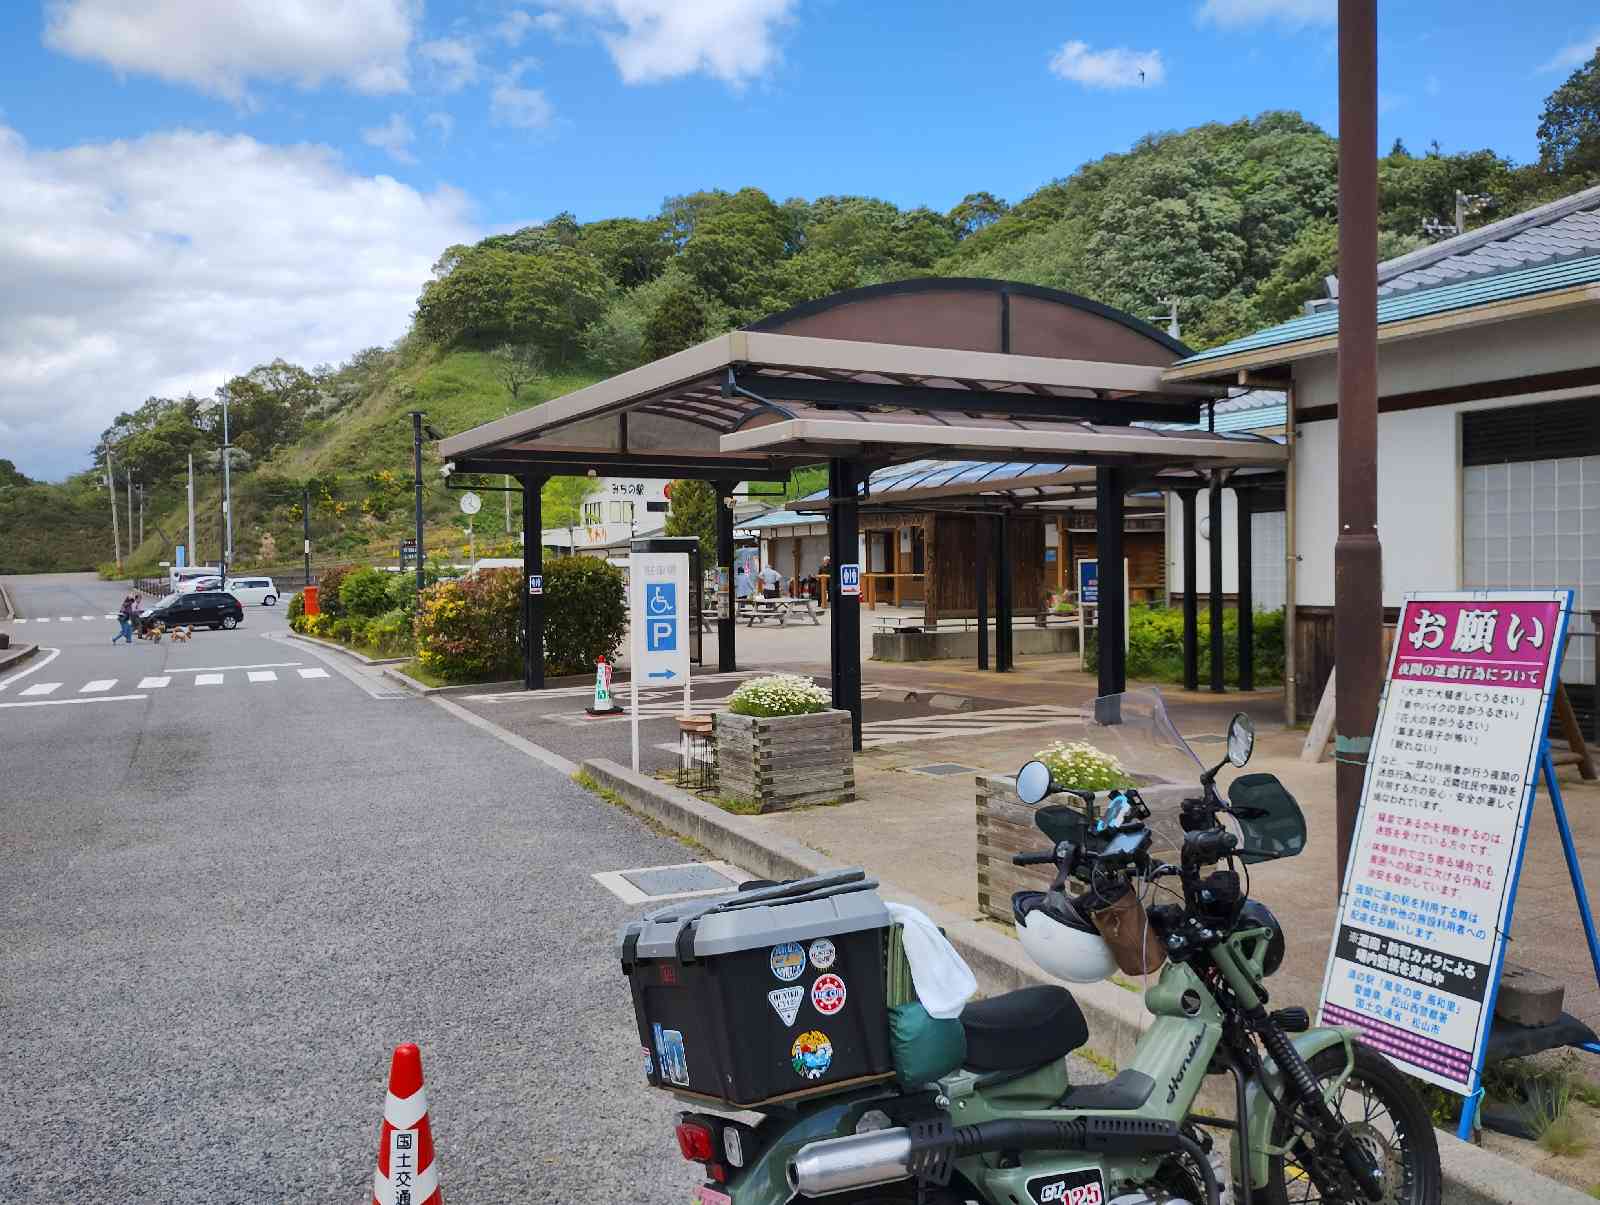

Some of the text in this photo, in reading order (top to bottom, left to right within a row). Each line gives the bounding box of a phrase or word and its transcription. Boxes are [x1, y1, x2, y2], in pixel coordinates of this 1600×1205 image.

[612, 482, 645, 496] みちの駅
[653, 622, 673, 648] P
[1408, 608, 1545, 654] お願い
[1398, 662, 1542, 684] 夜間の迷惑行為について
[1166, 1022, 1208, 1104] Honda
[395, 1133, 413, 1205] 国土交通
